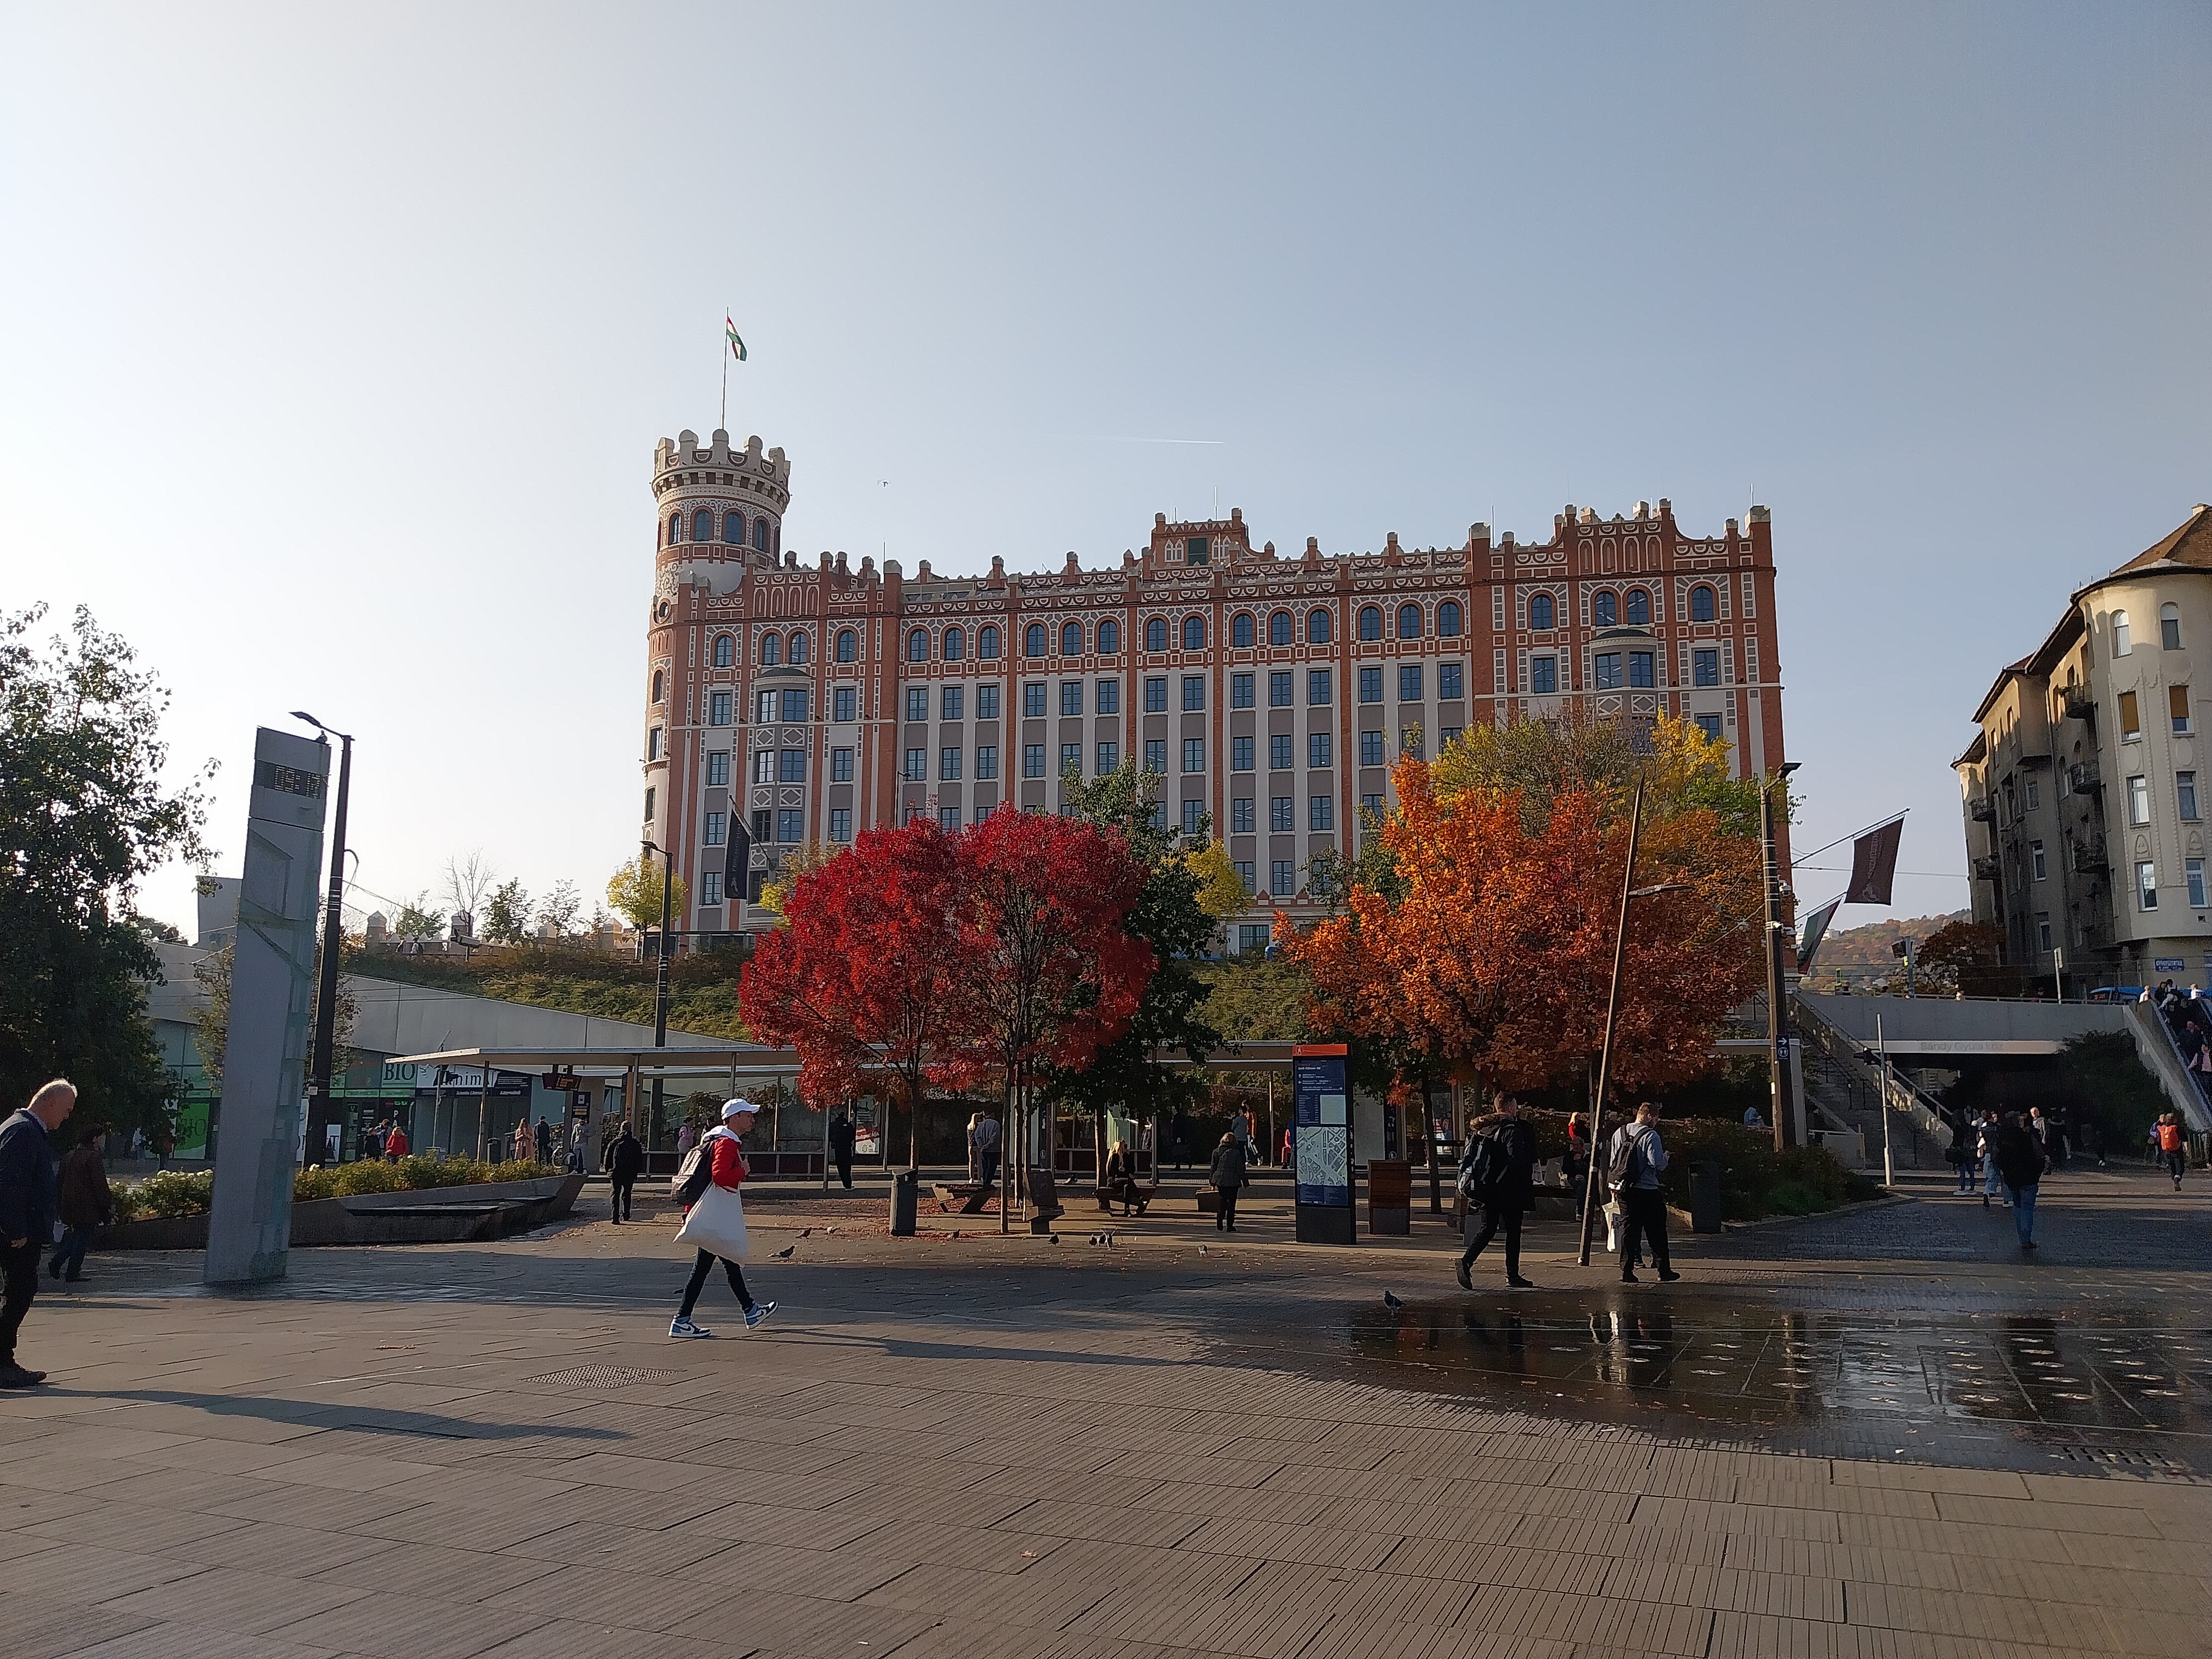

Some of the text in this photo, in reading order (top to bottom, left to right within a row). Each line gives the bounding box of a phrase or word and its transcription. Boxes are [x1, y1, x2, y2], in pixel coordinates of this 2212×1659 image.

[1920, 1041, 1952, 1052] Sándy
[1954, 1041, 1983, 1052] Gyula
[383, 1063, 416, 1081] BIO
[433, 1064, 490, 1085] Anim
